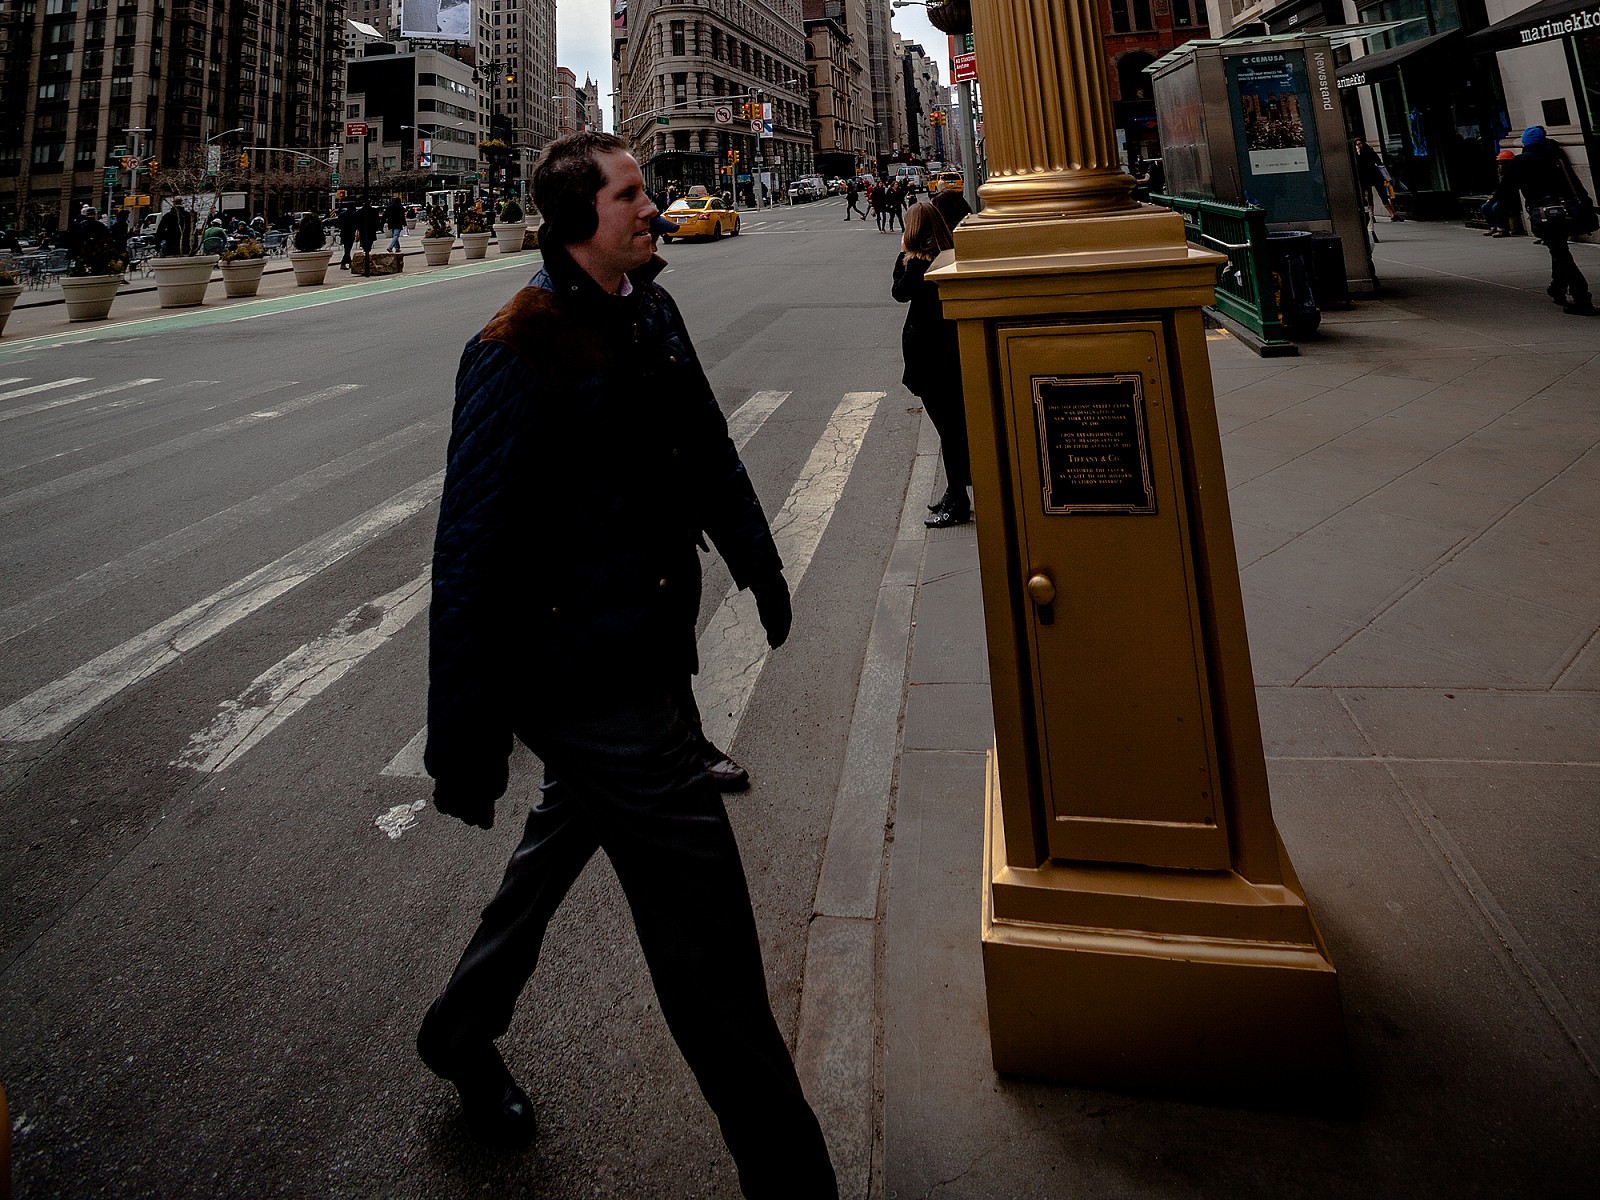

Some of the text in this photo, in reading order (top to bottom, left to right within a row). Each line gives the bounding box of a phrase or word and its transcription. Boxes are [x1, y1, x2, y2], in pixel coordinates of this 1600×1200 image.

[1520, 9, 1600, 43] marimekko
[1251, 55, 1285, 63] CEMUSA
[1313, 52, 1334, 111] Newsstand
[1336, 73, 1366, 89] arimekko
